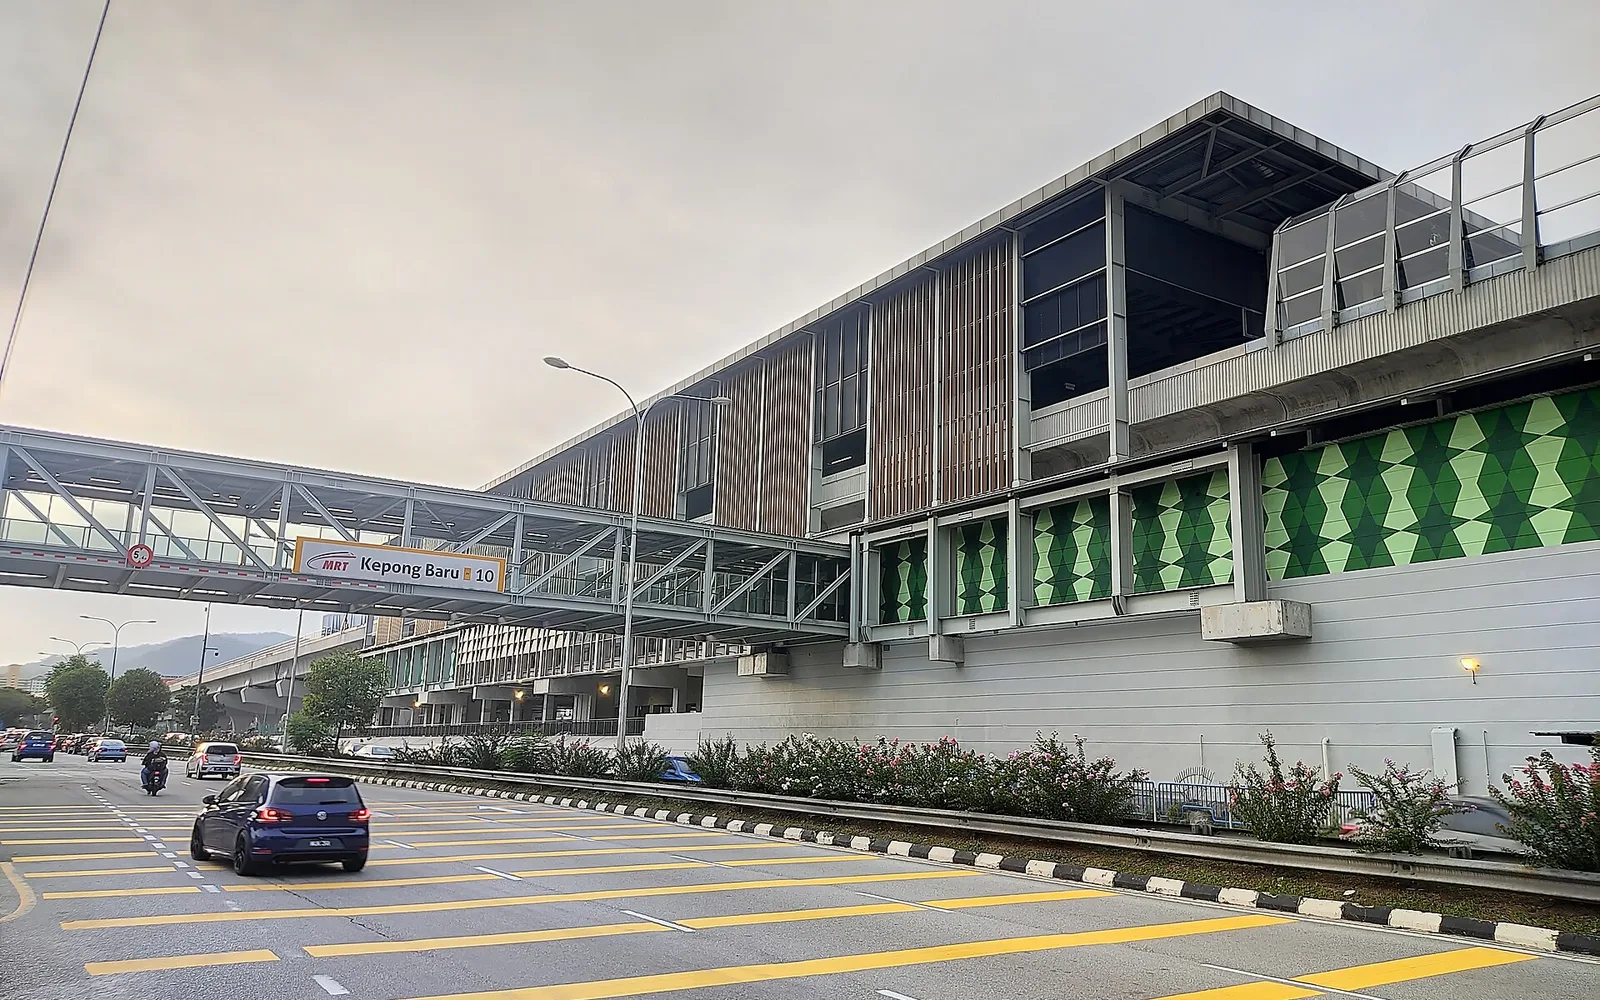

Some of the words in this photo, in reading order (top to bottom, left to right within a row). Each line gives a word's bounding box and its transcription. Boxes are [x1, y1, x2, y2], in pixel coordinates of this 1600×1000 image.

[322, 560, 350, 572] MRT
[360, 556, 422, 579] Kepong
[425, 563, 460, 579] Baru
[475, 568, 495, 583] 10
